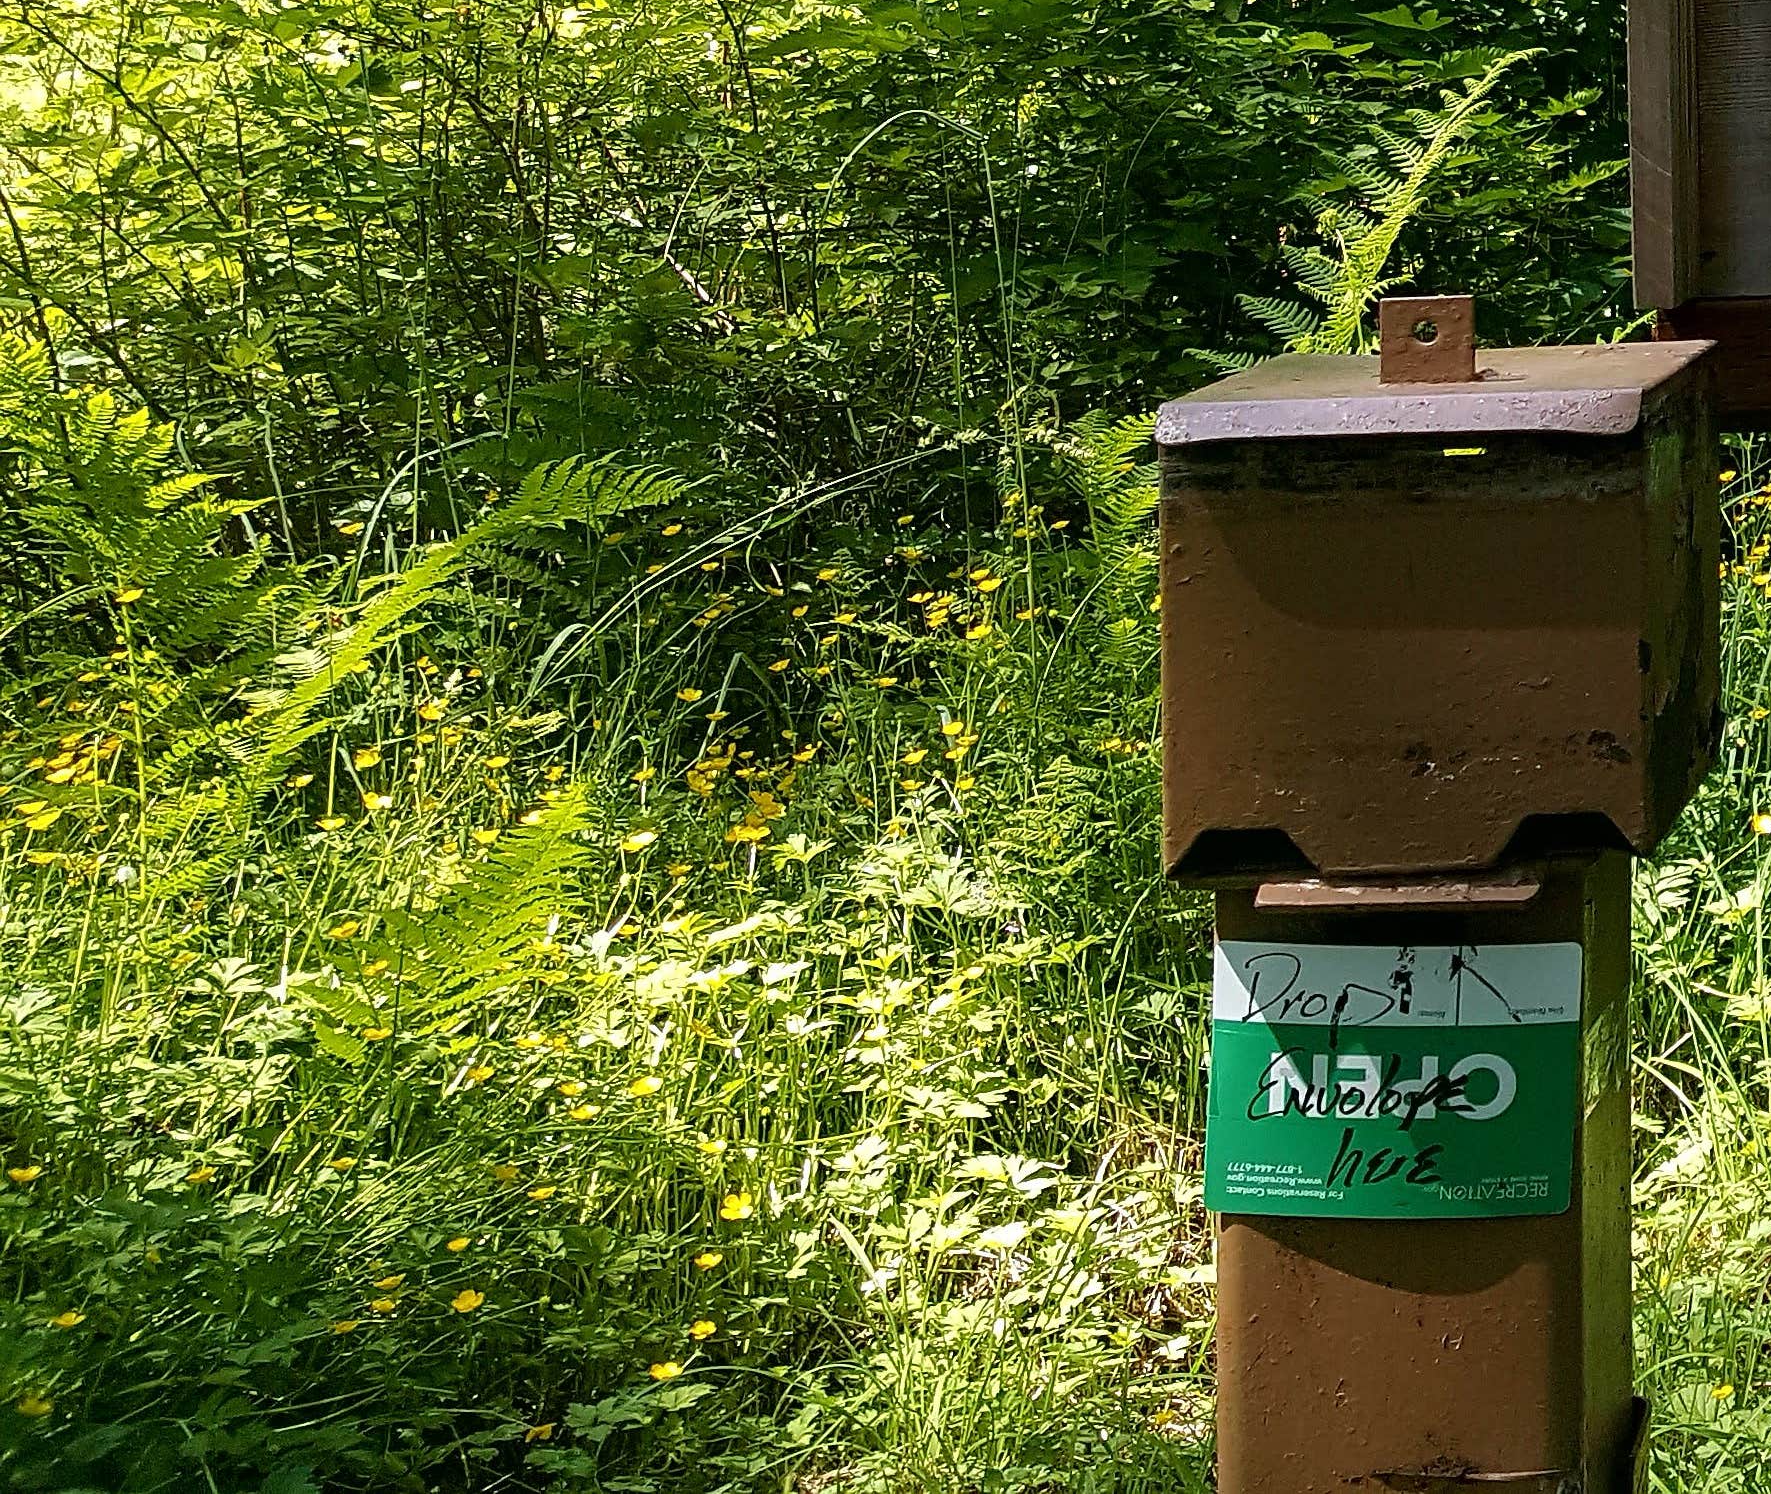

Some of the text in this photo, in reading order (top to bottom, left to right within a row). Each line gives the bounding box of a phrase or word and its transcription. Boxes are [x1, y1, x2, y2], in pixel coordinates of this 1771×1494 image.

[1242, 953, 1396, 1049] Drop
[1268, 1052, 1517, 1120] OPEN
[1227, 1162, 1302, 1174] 1-877-444-6777
[1226, 1174, 1322, 1186] www.Recreation.gov
[1226, 1186, 1344, 1200] For Reservations Contact:
